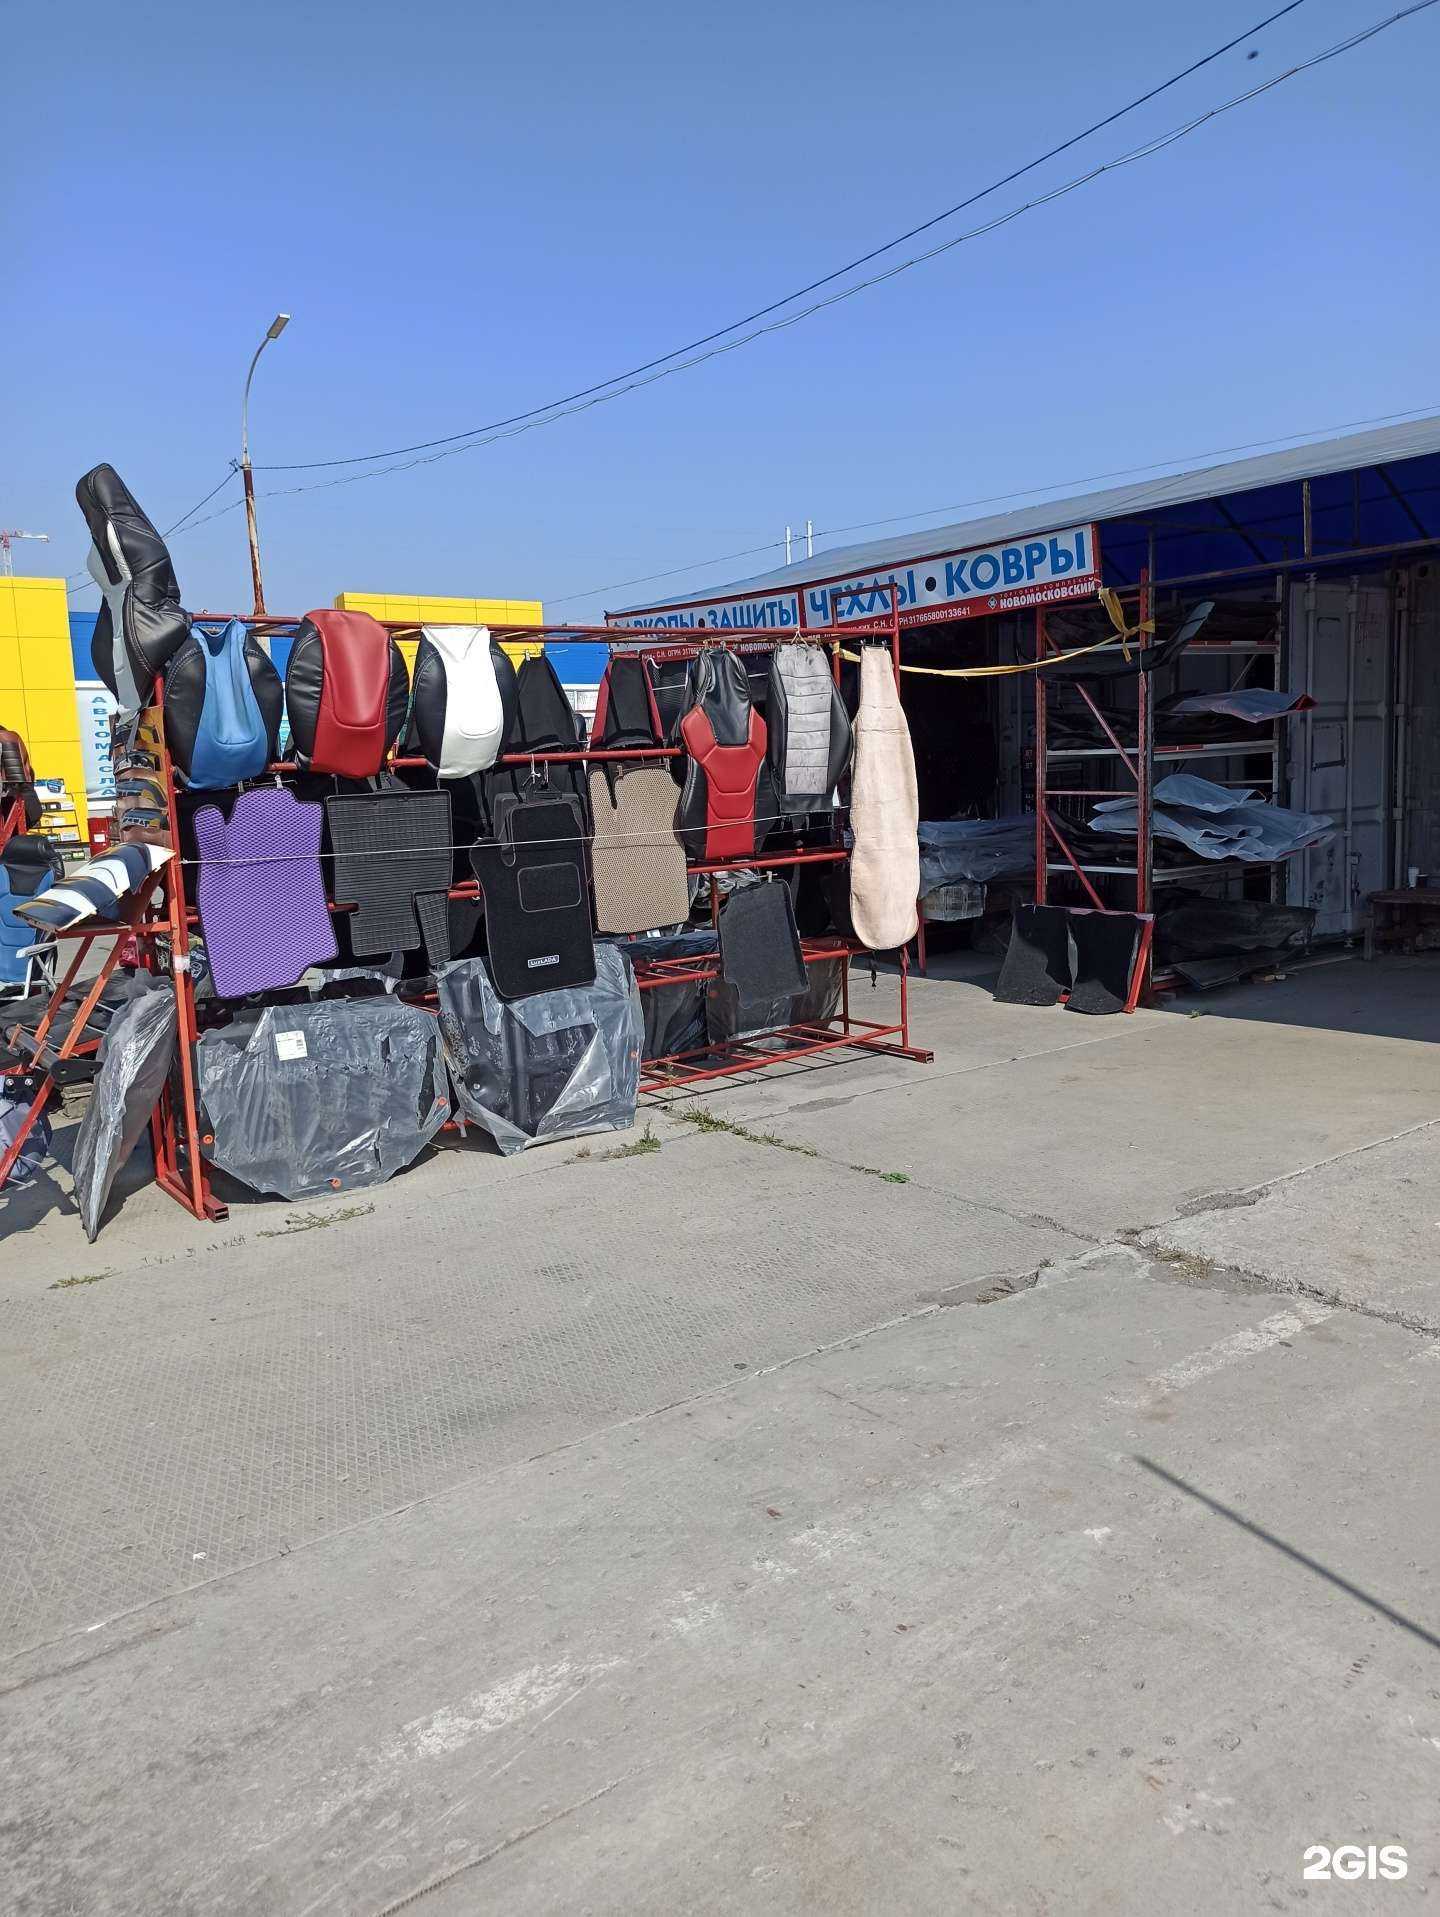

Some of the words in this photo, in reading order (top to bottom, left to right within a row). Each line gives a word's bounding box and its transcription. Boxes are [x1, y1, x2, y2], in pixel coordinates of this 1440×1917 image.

[809, 571, 917, 621] ЧЕХЛЫ
[944, 531, 1087, 597] КОВРЫ
[999, 577, 1096, 609] НОВОМОСКОВСКИЙ
[707, 598, 798, 629] ЗАЩИТЫ
[91, 696, 116, 797] АВТОМАСЛА
